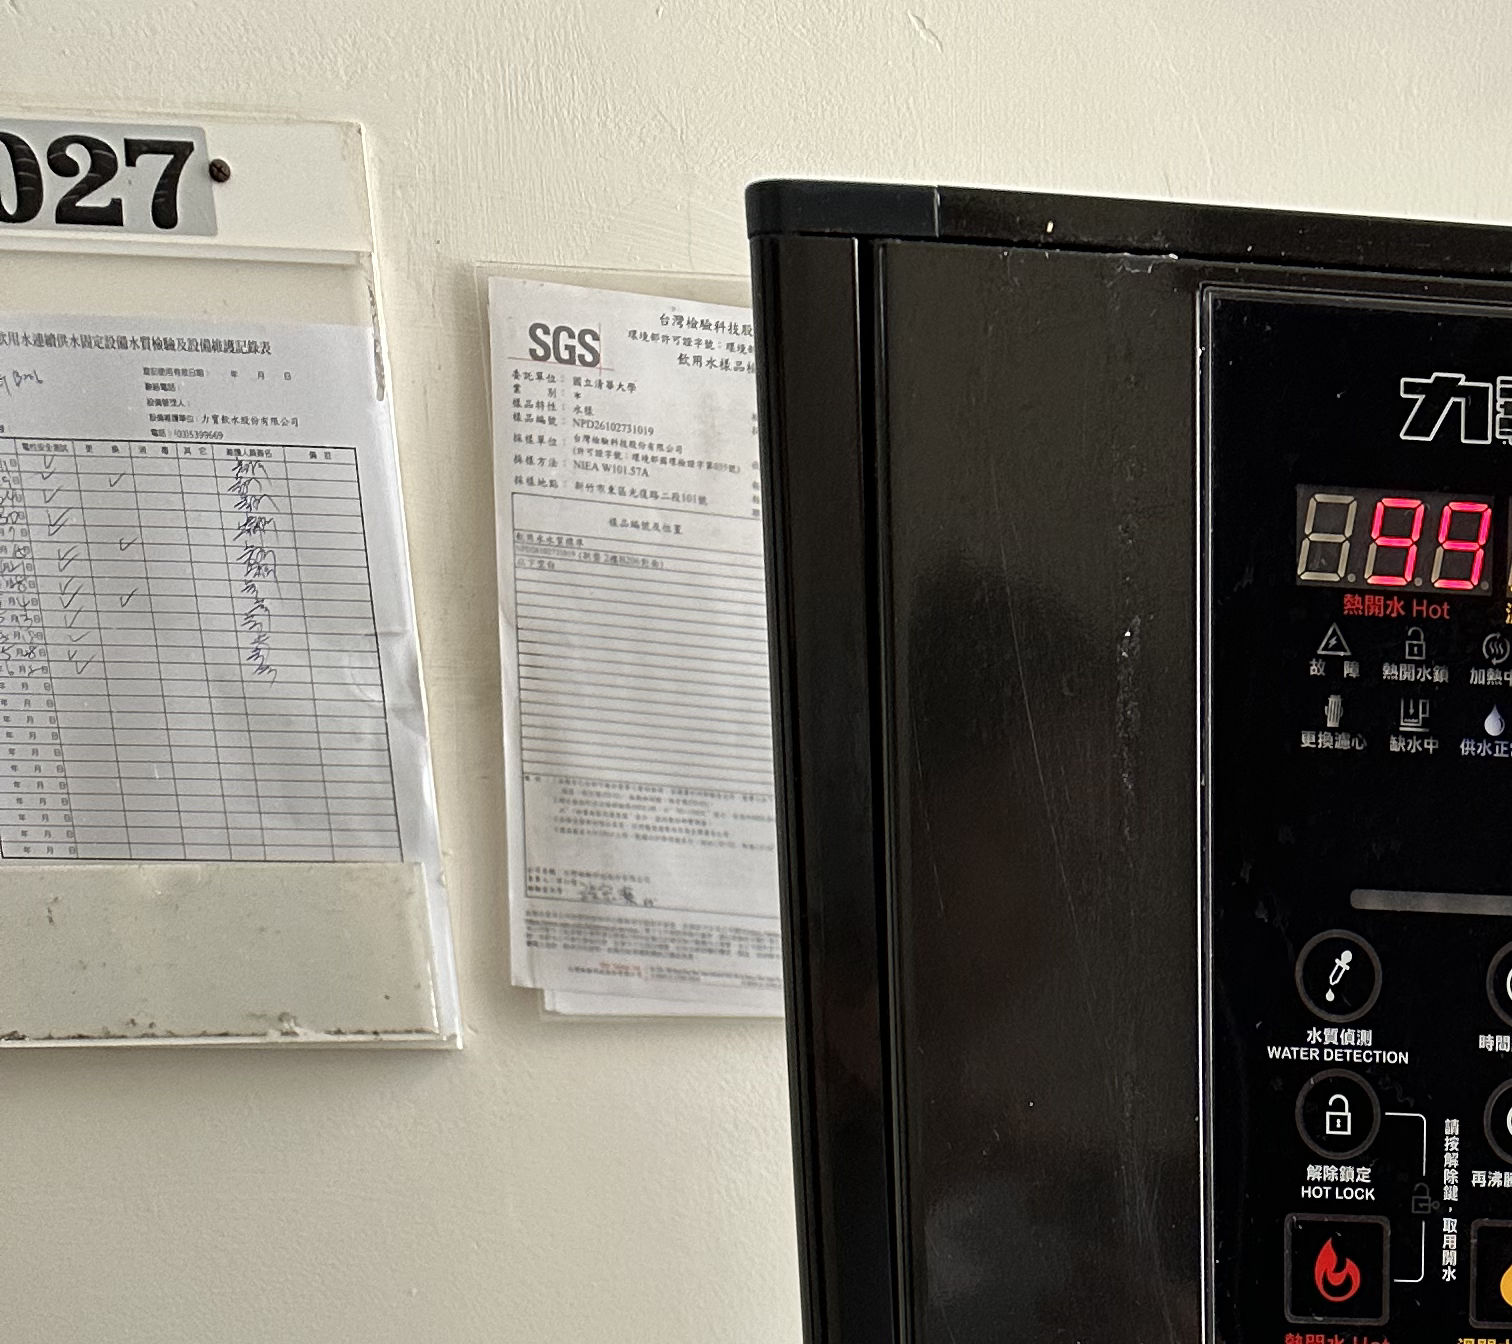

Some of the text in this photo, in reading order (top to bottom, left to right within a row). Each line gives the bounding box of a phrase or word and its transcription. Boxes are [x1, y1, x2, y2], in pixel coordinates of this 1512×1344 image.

[528, 322, 601, 368] SGS
[257, 370, 265, 380] 月
[573, 376, 637, 394] 國立清華大學
[1342, 593, 1451, 620] 熱開水 Hot
[1382, 662, 1449, 683] 熱開水鎖
[1300, 730, 1367, 750] 更換濾心
[1389, 735, 1439, 755] 缺水中
[1306, 1027, 1373, 1047] 水質偵測
[1267, 1046, 1409, 1065] WATER DETECTION
[1306, 1164, 1372, 1184] 解除鎖定
[1301, 1186, 1376, 1201] HOT LOCK
